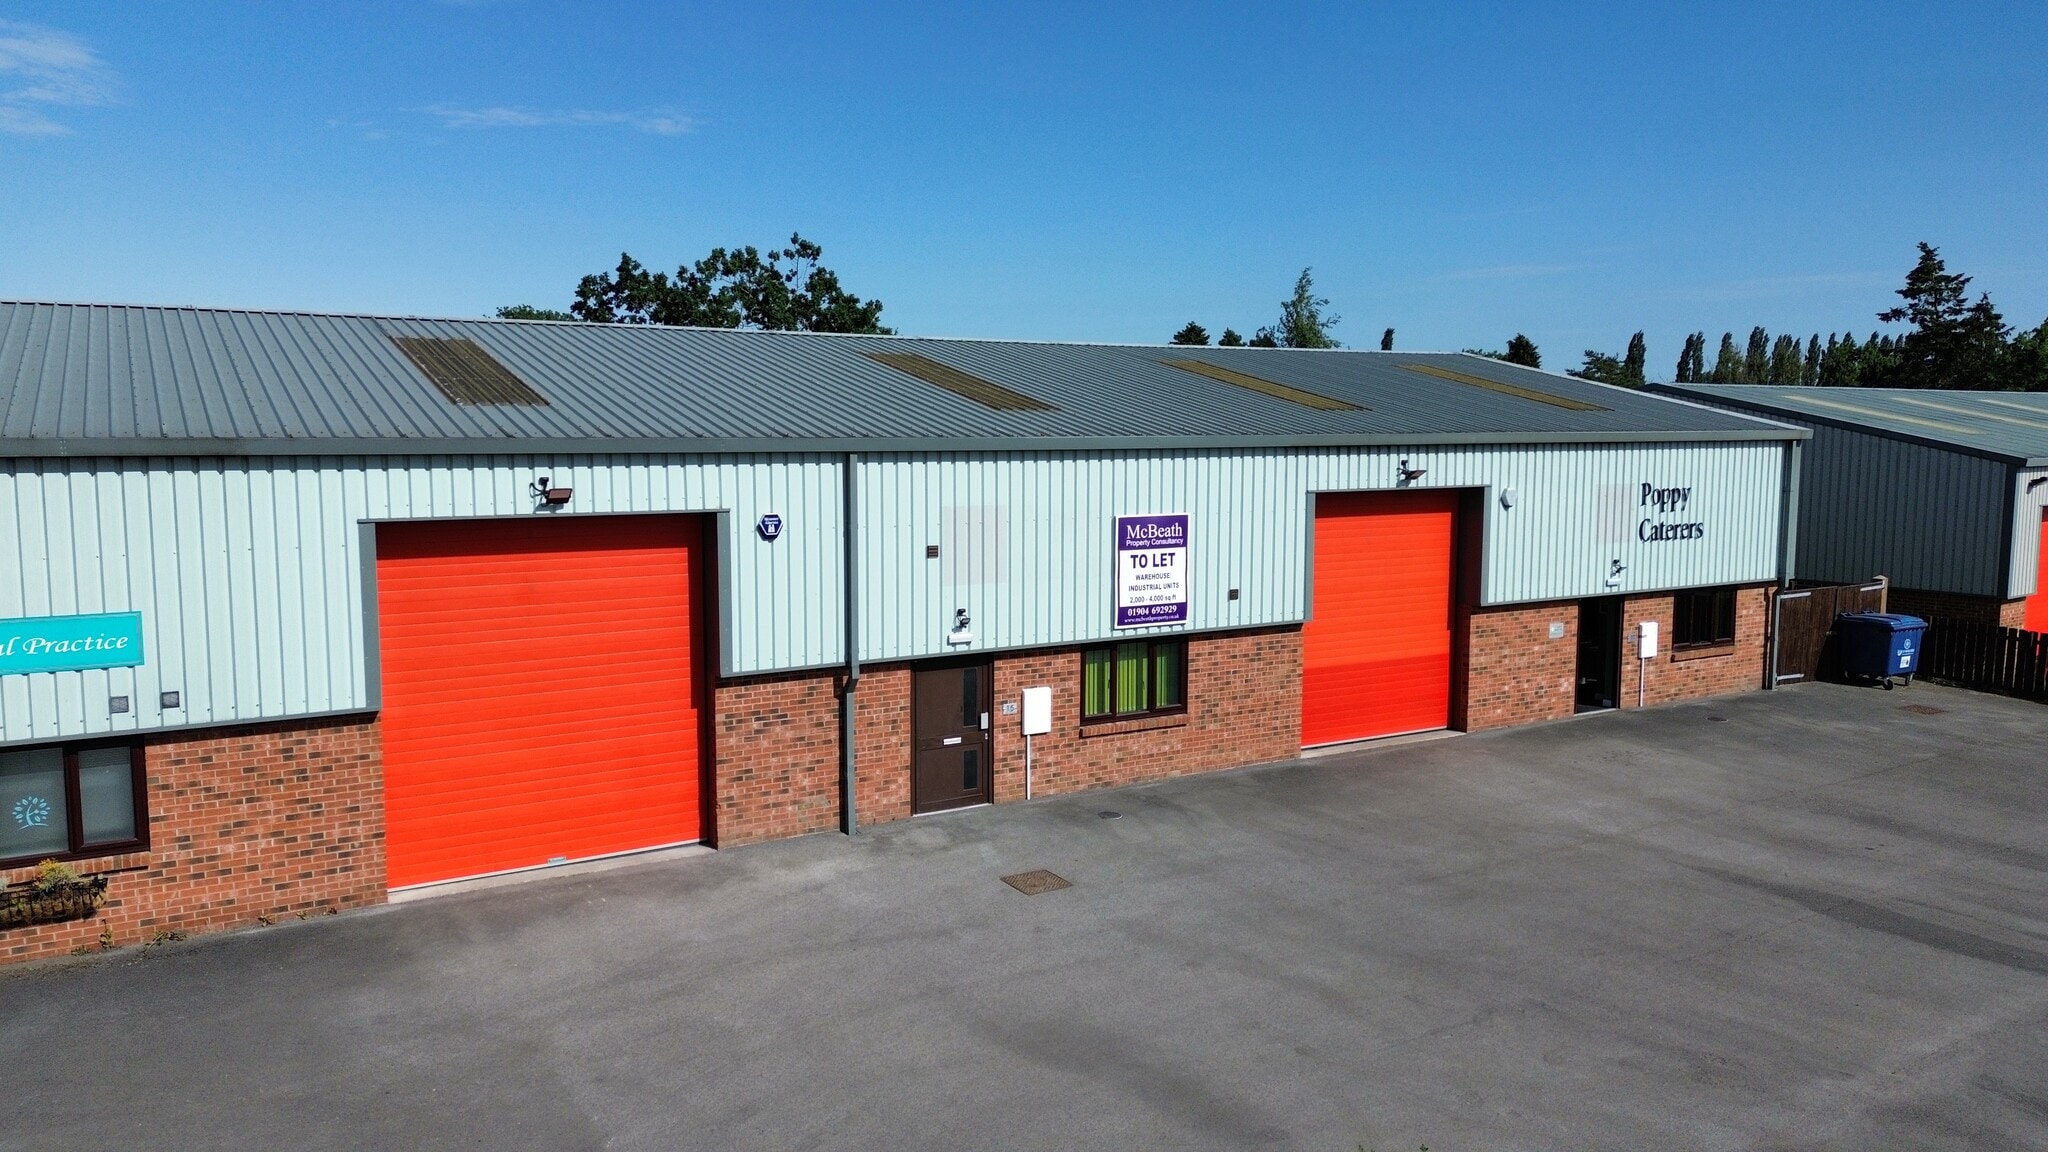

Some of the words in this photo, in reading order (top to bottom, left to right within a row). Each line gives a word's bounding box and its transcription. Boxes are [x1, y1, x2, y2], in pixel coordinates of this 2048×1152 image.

[1640, 482, 1691, 513] Poppy
[1126, 522, 1183, 539] McBeath
[1639, 518, 1704, 543] Caterers
[1126, 539, 1150, 547] Property
[1130, 554, 1148, 569] TO
[1152, 552, 1176, 568] LET
[1128, 584, 1162, 592] INDUSTRIAL
[1163, 582, 1179, 590] UNITS
[1129, 596, 1145, 604] 2,000
[1149, 594, 1164, 603] 4,000
[1127, 607, 1149, 616] 01904
[1151, 604, 1178, 615] 692929
[22, 633, 129, 655] Practice
